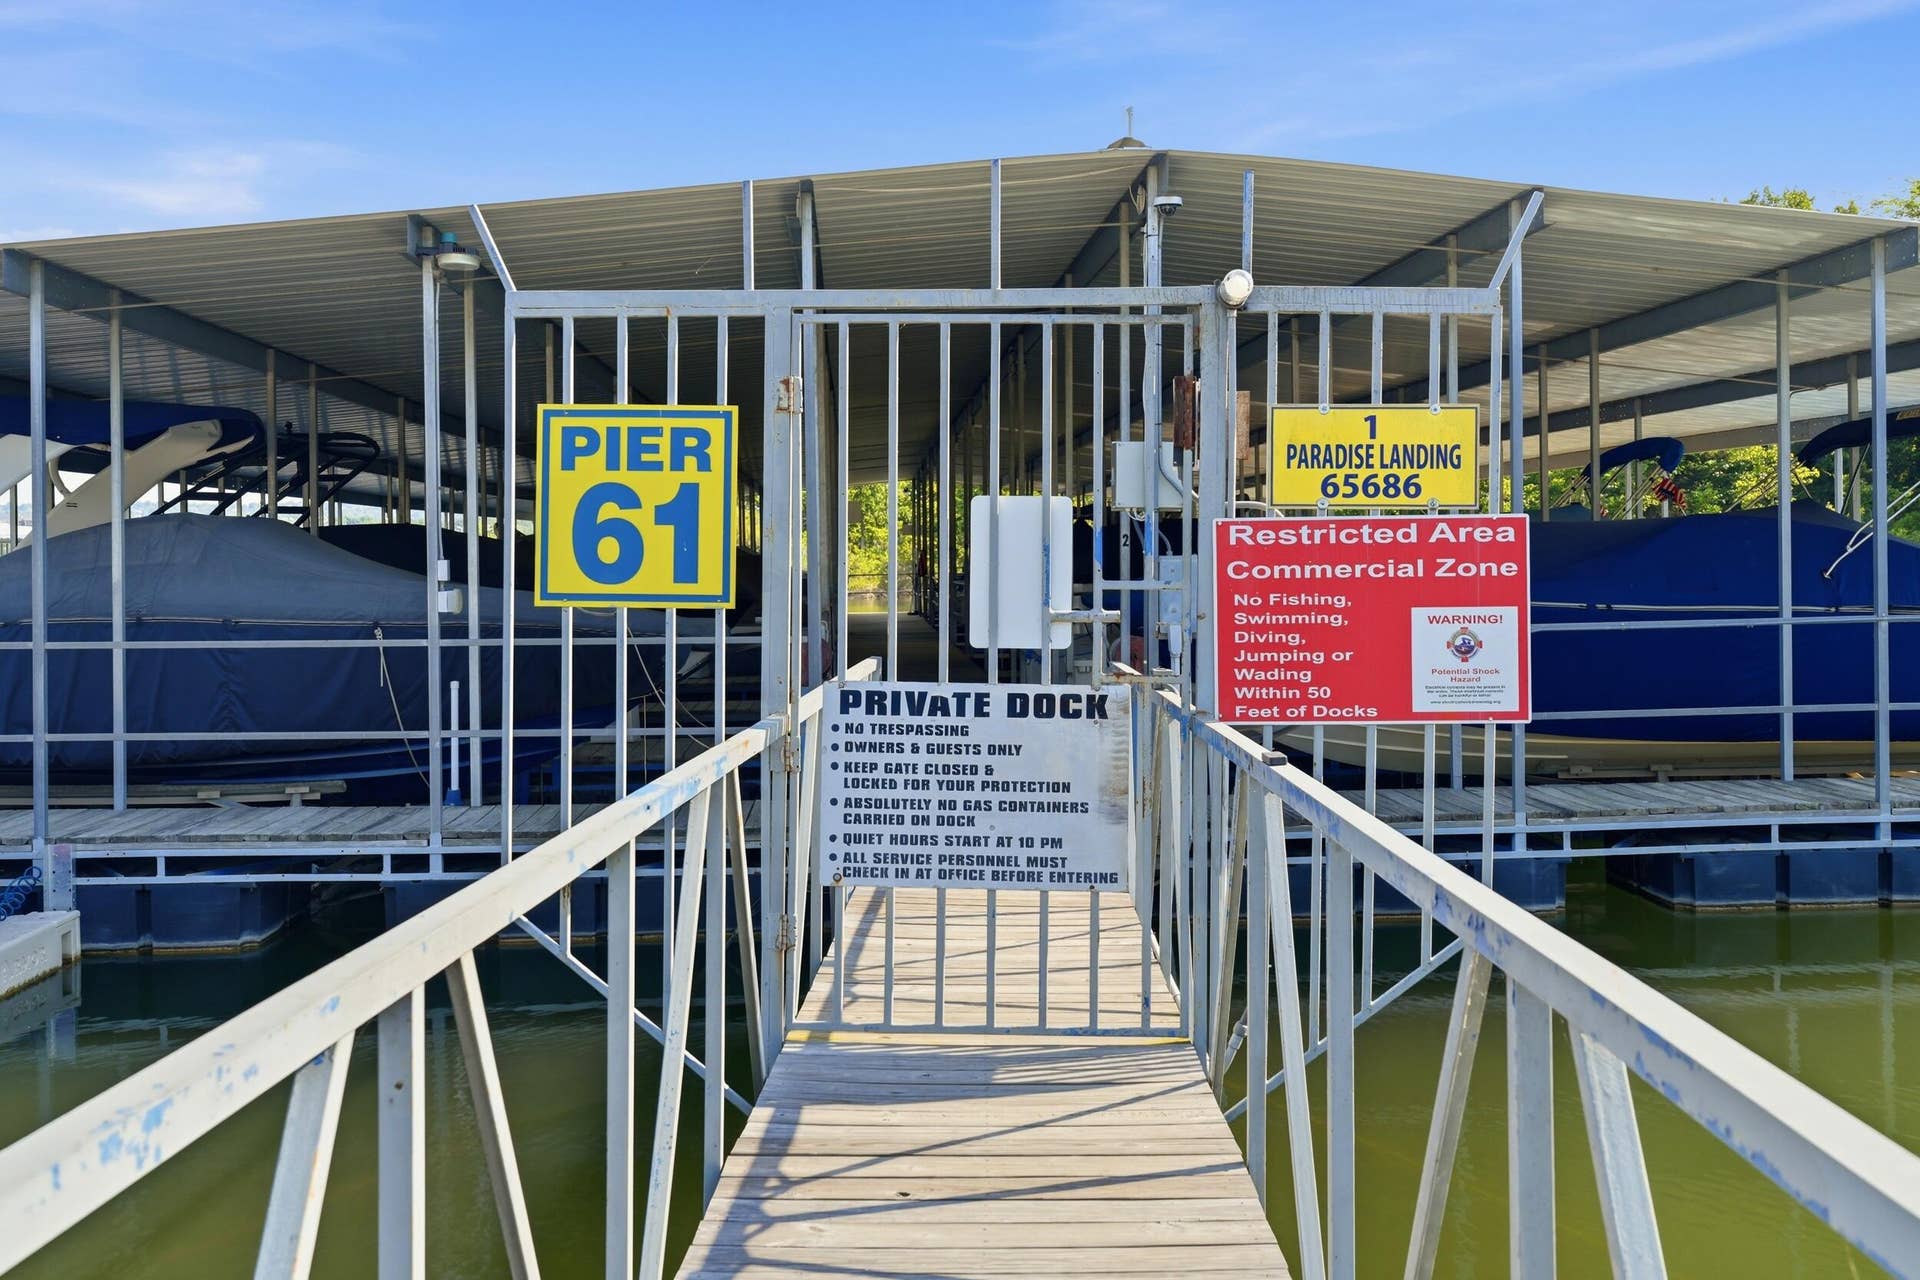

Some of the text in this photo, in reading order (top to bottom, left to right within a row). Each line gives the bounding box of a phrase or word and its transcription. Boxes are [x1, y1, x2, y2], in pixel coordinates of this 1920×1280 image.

[1364, 415, 1377, 439] 1
[561, 426, 712, 472] PIER
[1287, 444, 1461, 469] PARADISE LANDING
[1321, 474, 1421, 498] 65686
[572, 482, 699, 584] 61
[1122, 533, 1130, 547] 2
[1229, 523, 1515, 545] Restricted Area
[1227, 558, 1518, 579] Commercial Zone
[1234, 593, 1351, 608] No Fishing,
[1234, 612, 1348, 626] Swimming,
[1427, 614, 1503, 624] WARNING!
[1235, 631, 1306, 645] Diving,
[1234, 650, 1354, 663] Jumping or
[1234, 668, 1311, 682] Wading
[1235, 687, 1330, 699] Within 50
[839, 690, 1109, 719] PRIVATE DOCK
[1236, 705, 1377, 717] Feet of Docks
[845, 723, 969, 736] NO TRESPASSING
[845, 742, 1022, 756] OWNERS & GUESTS ONLY
[844, 762, 994, 776] KEEP GATE CLOSED &
[844, 778, 1071, 793] LOCKED FOR YOUR PROTECTION
[844, 797, 1089, 813] ABSOLUTELY NO GAS CONTAINERS
[844, 813, 976, 827] CARRIED ON DOCK
[843, 833, 1062, 849] QUIET HOURS START AT 10 PM
[843, 853, 1067, 868] ALL SERVICE PERSONNEL MUST
[843, 867, 1118, 884] CHECK IN AT OFFICE BEFORE ENTERING
